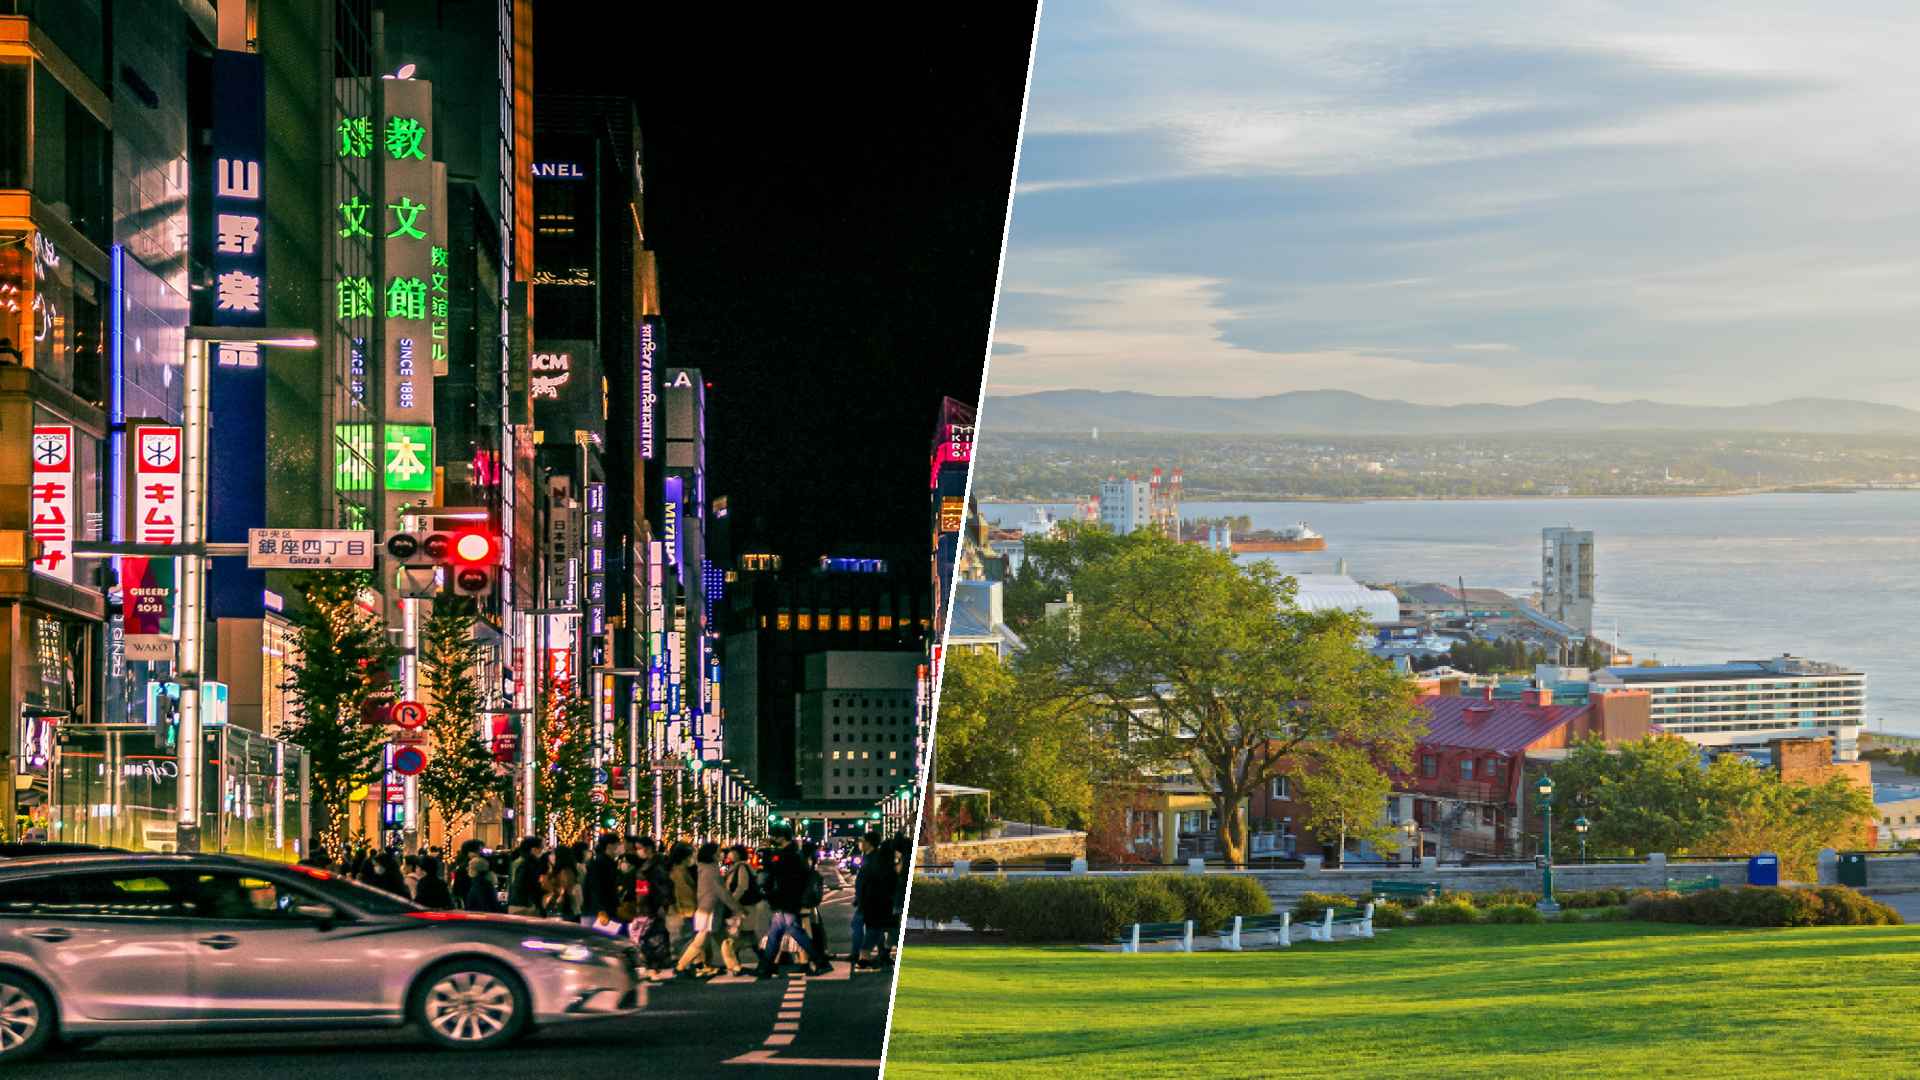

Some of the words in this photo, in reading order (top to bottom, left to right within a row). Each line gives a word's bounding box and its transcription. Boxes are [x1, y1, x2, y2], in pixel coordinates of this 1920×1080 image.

[384, 114, 428, 321] 教文館
[400, 338, 414, 376] SINCE
[400, 380, 414, 408] 1885
[386, 436, 427, 482] 本
[258, 539, 365, 556] 銀座四丁目
[288, 556, 320, 565] Ginza
[324, 556, 332, 564] 4
[130, 588, 169, 596] CHEERS
[137, 604, 163, 612] 2021
[133, 643, 168, 652] WAKO
